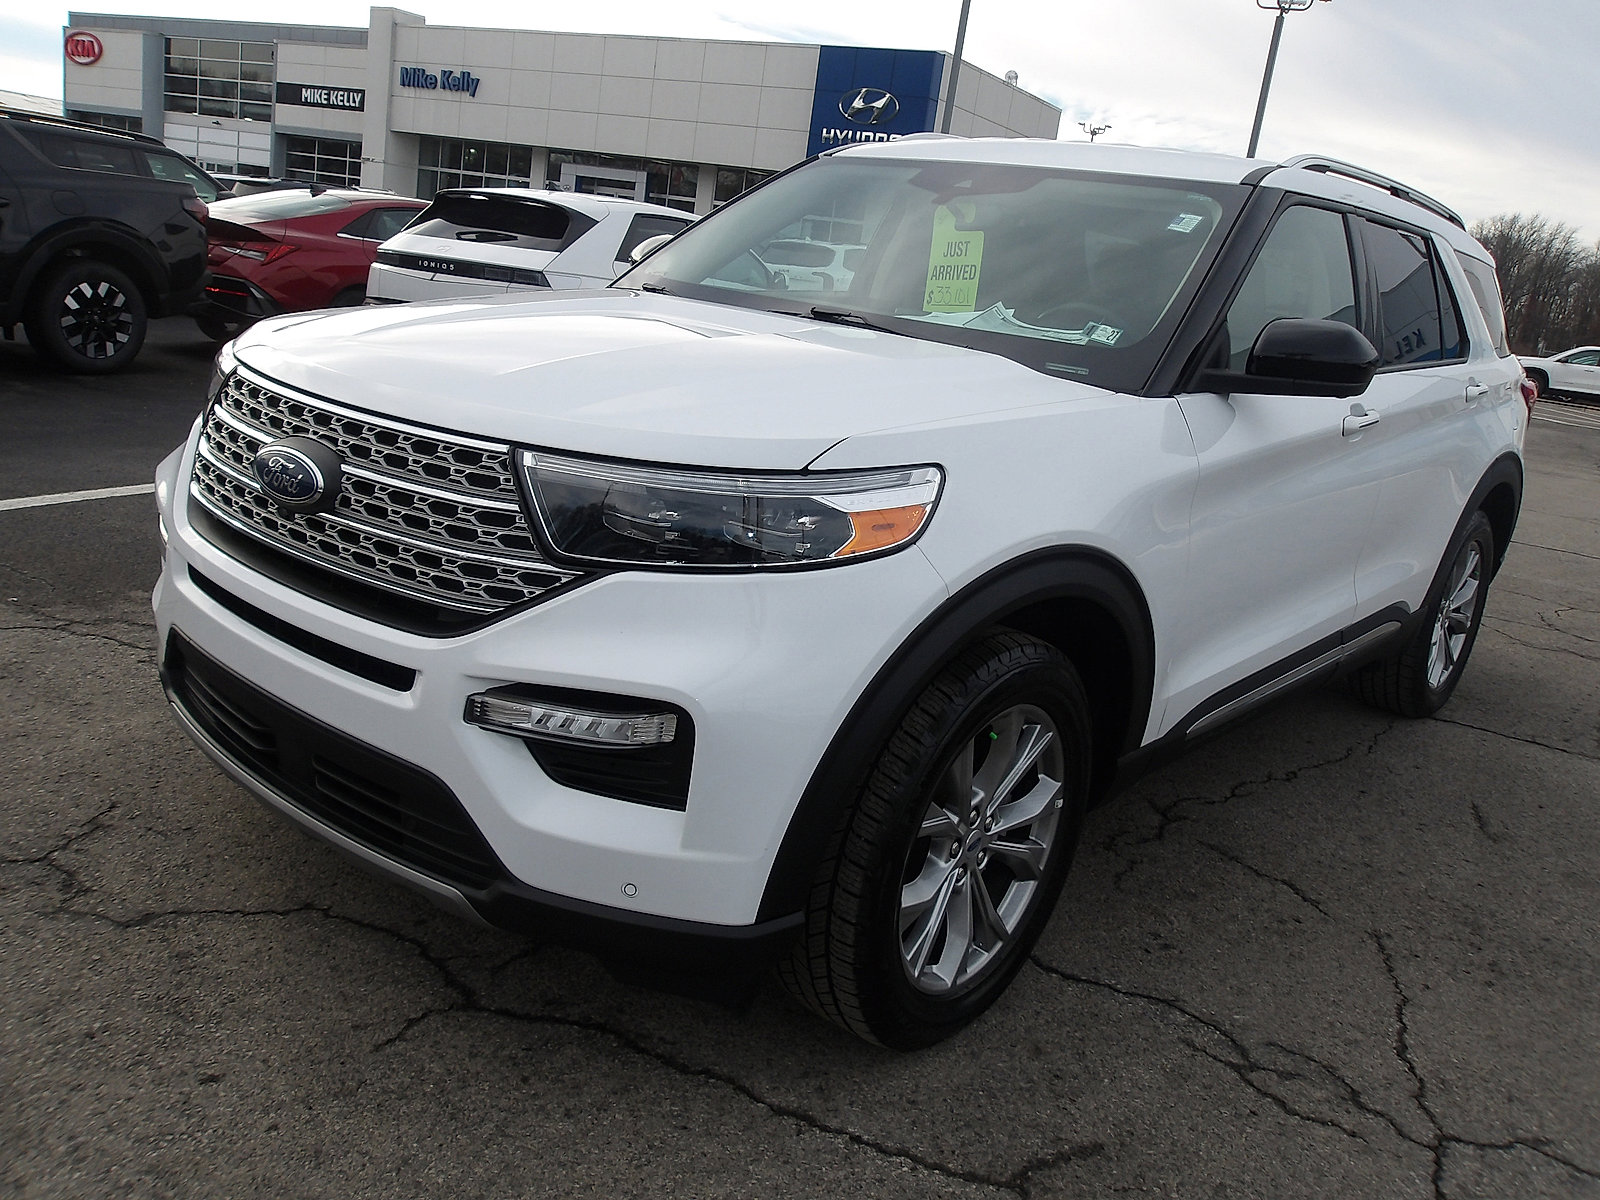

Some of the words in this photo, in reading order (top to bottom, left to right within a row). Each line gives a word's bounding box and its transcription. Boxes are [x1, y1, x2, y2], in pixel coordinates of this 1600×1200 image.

[66, 37, 98, 58] KIA
[399, 66, 438, 90] Mike
[439, 69, 480, 98] Kelly
[301, 87, 328, 105] MIKE
[329, 90, 362, 108] KELLY
[943, 240, 971, 258] JUST
[930, 264, 977, 281] ARRIVED
[263, 456, 304, 494] Ford
